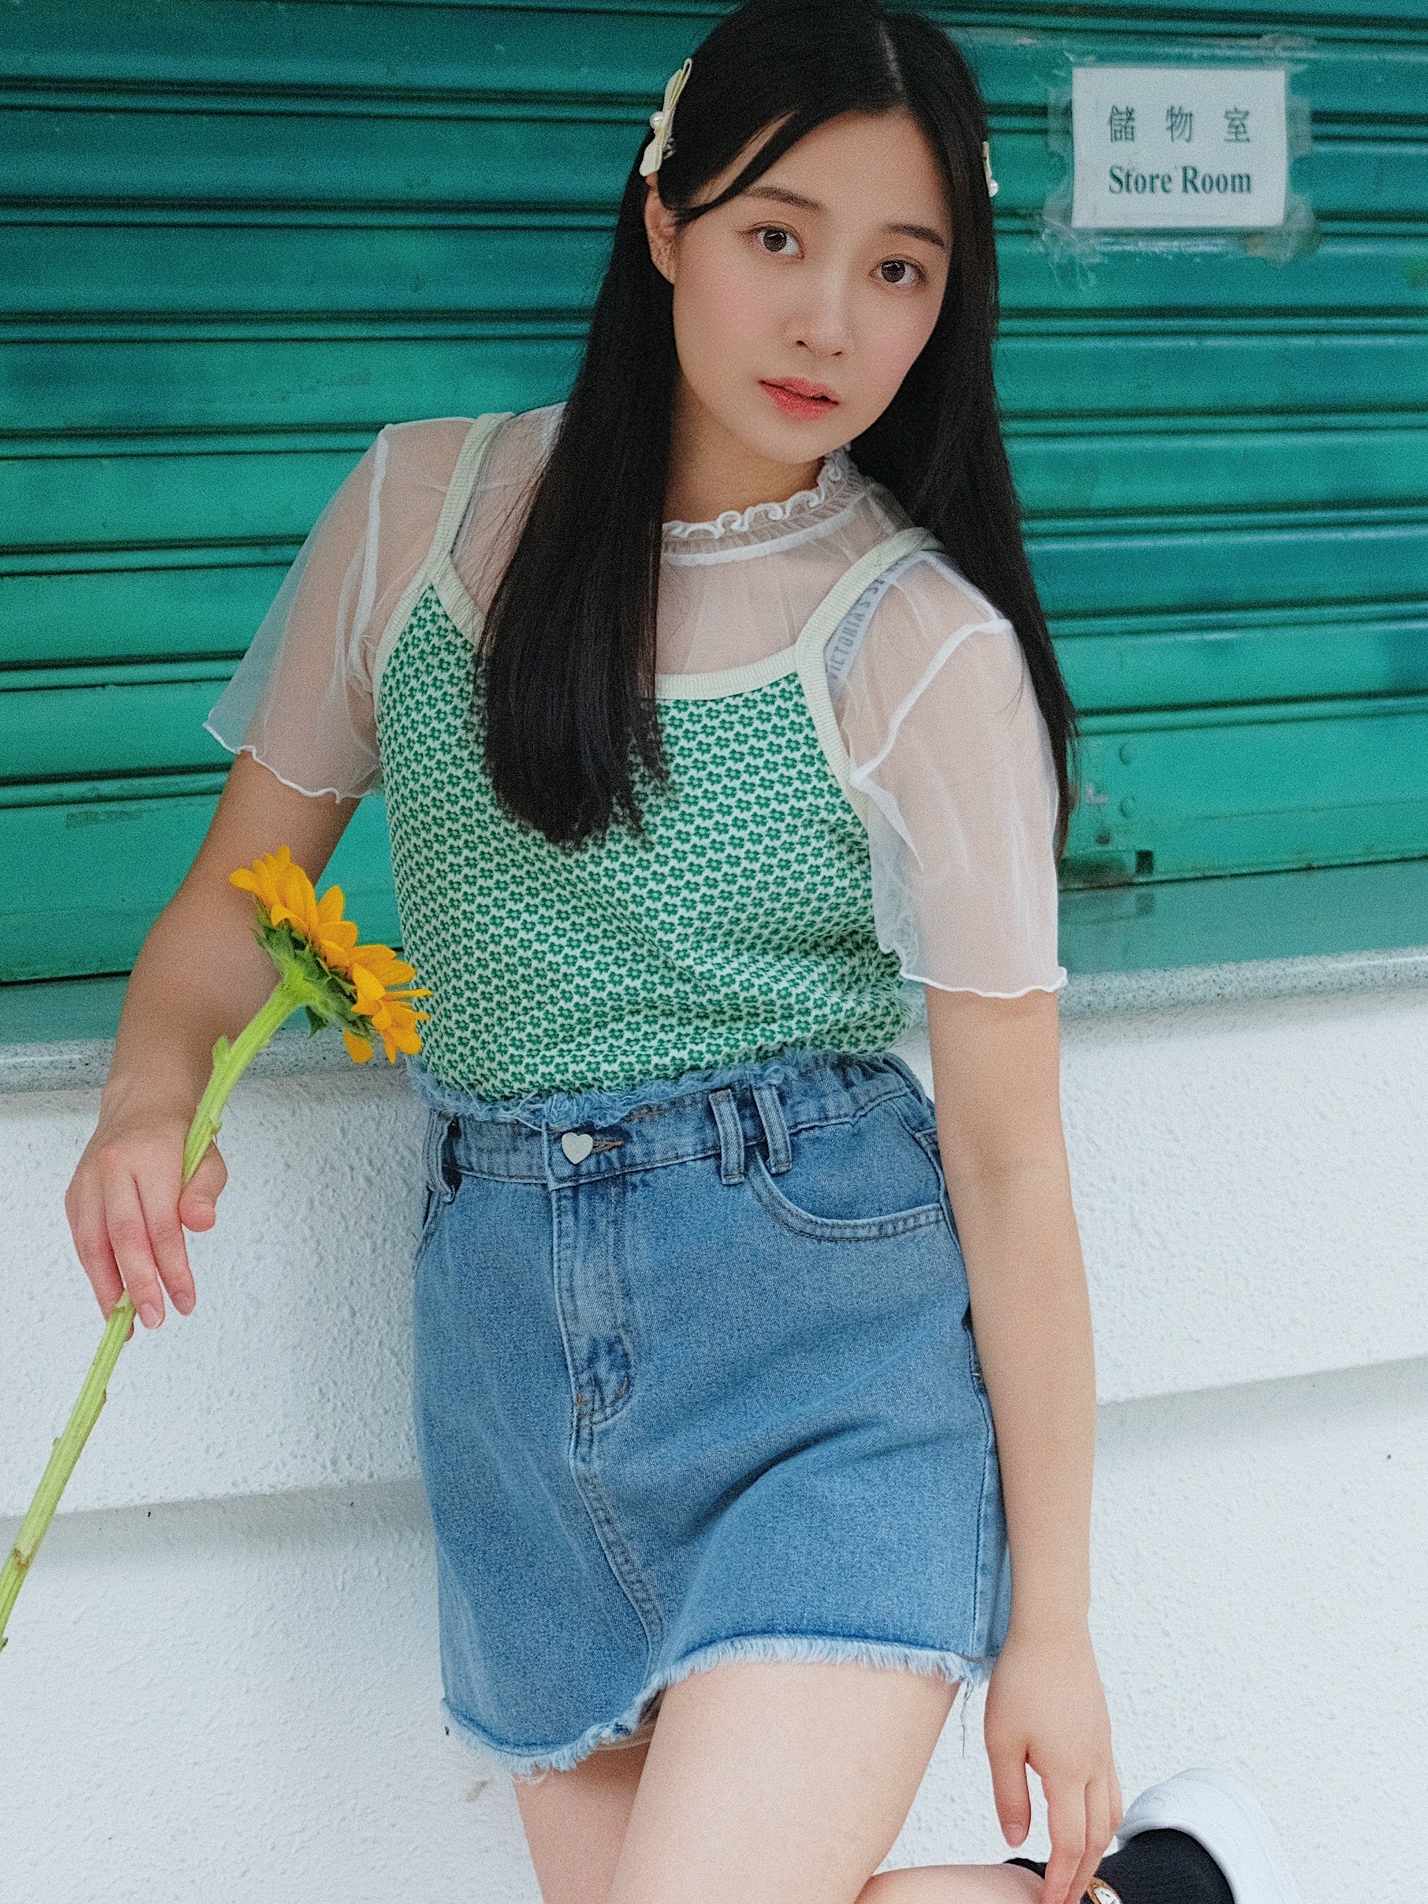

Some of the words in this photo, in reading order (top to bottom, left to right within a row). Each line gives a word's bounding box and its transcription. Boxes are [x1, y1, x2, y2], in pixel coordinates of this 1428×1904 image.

[1107, 104, 1251, 144] 儲物室
[1108, 165, 1173, 194] Store
[1181, 165, 1252, 194] Room
